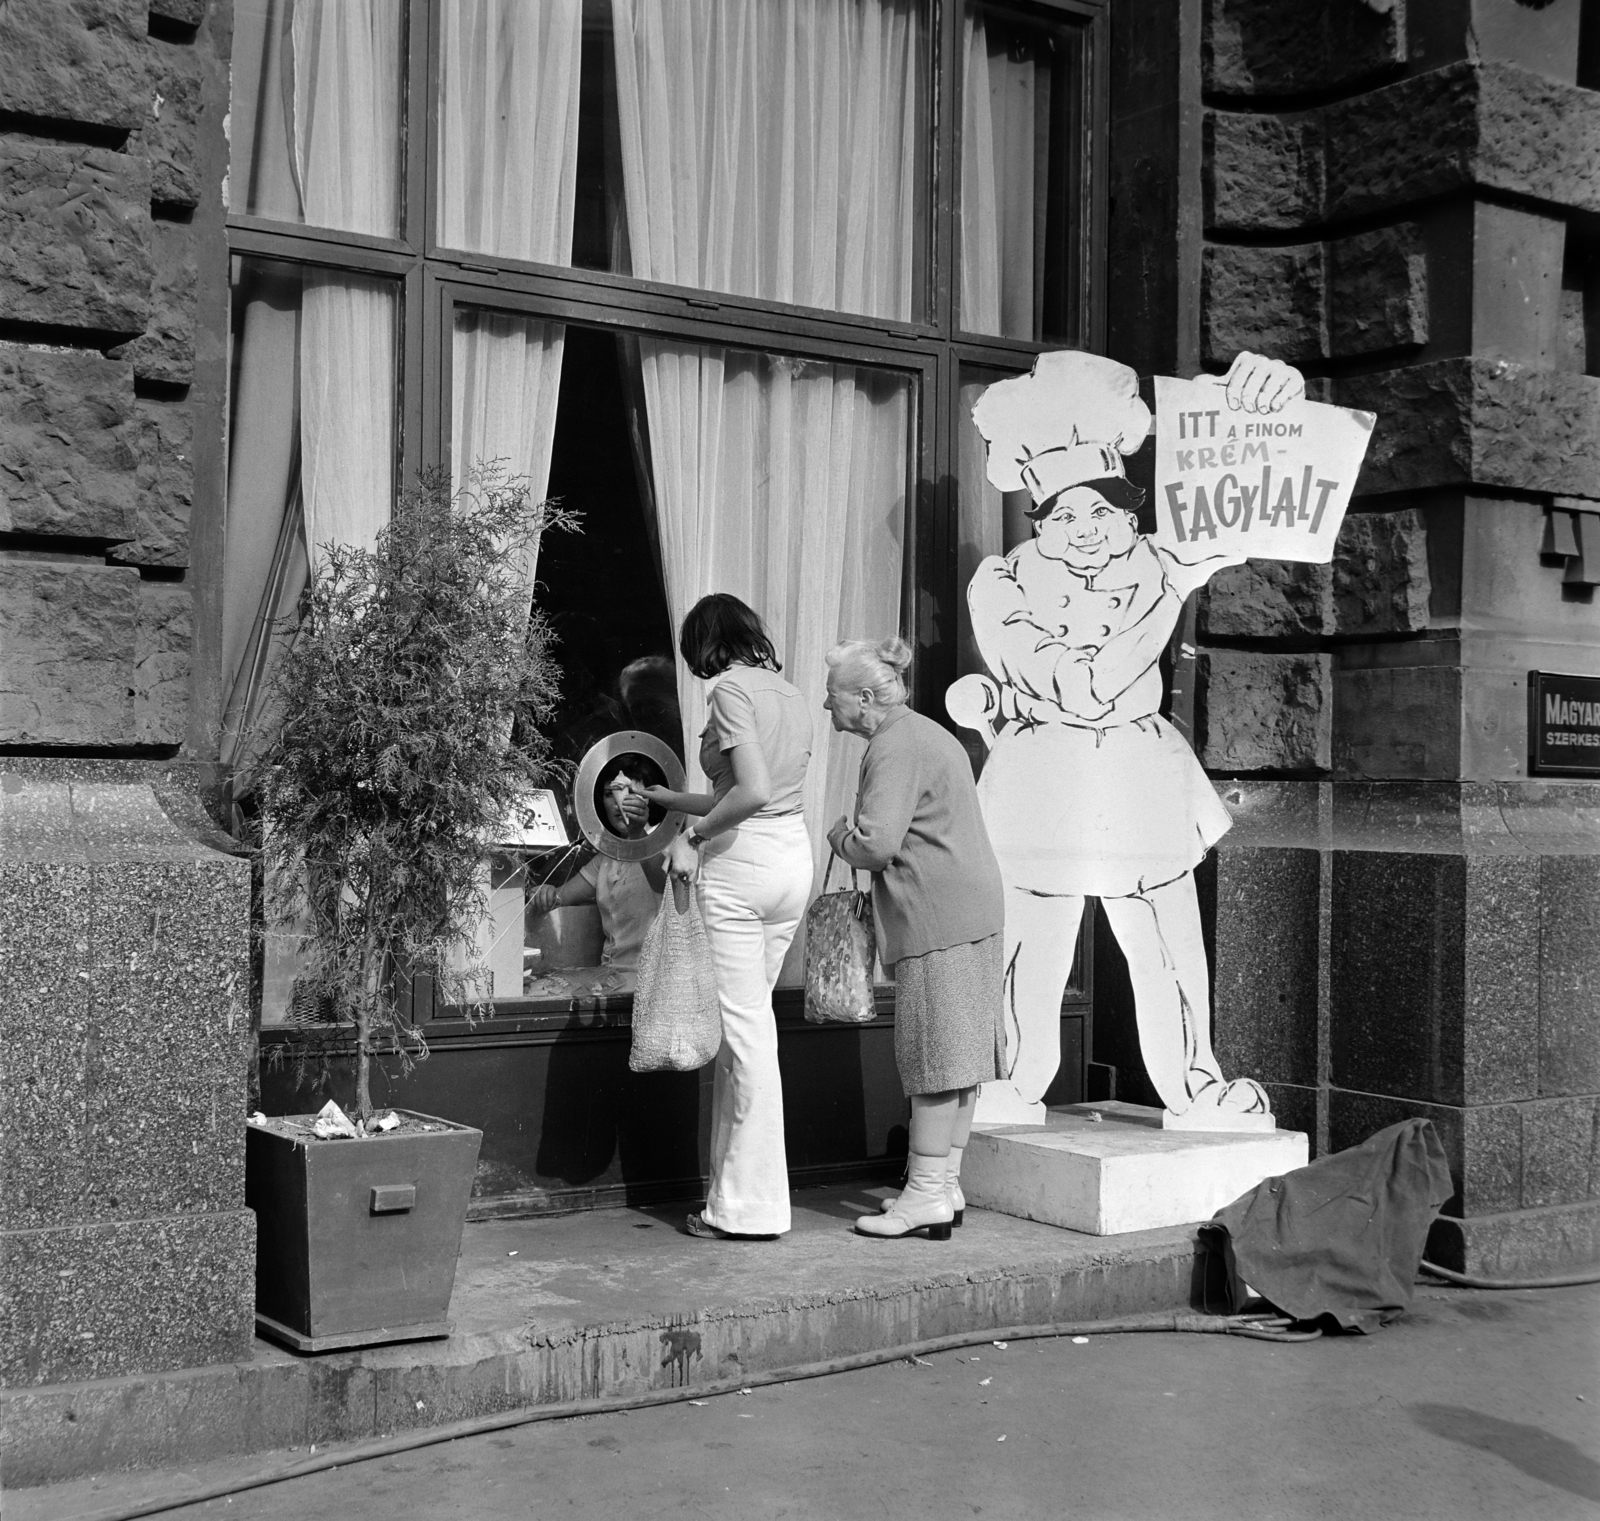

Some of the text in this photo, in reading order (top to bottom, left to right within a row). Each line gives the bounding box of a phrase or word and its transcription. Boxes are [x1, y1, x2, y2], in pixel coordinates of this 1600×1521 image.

[1179, 410, 1303, 439] ITT A FINOM
[1545, 693, 1600, 726] MAGYAR
[1546, 732, 1600, 746] SZERKES
